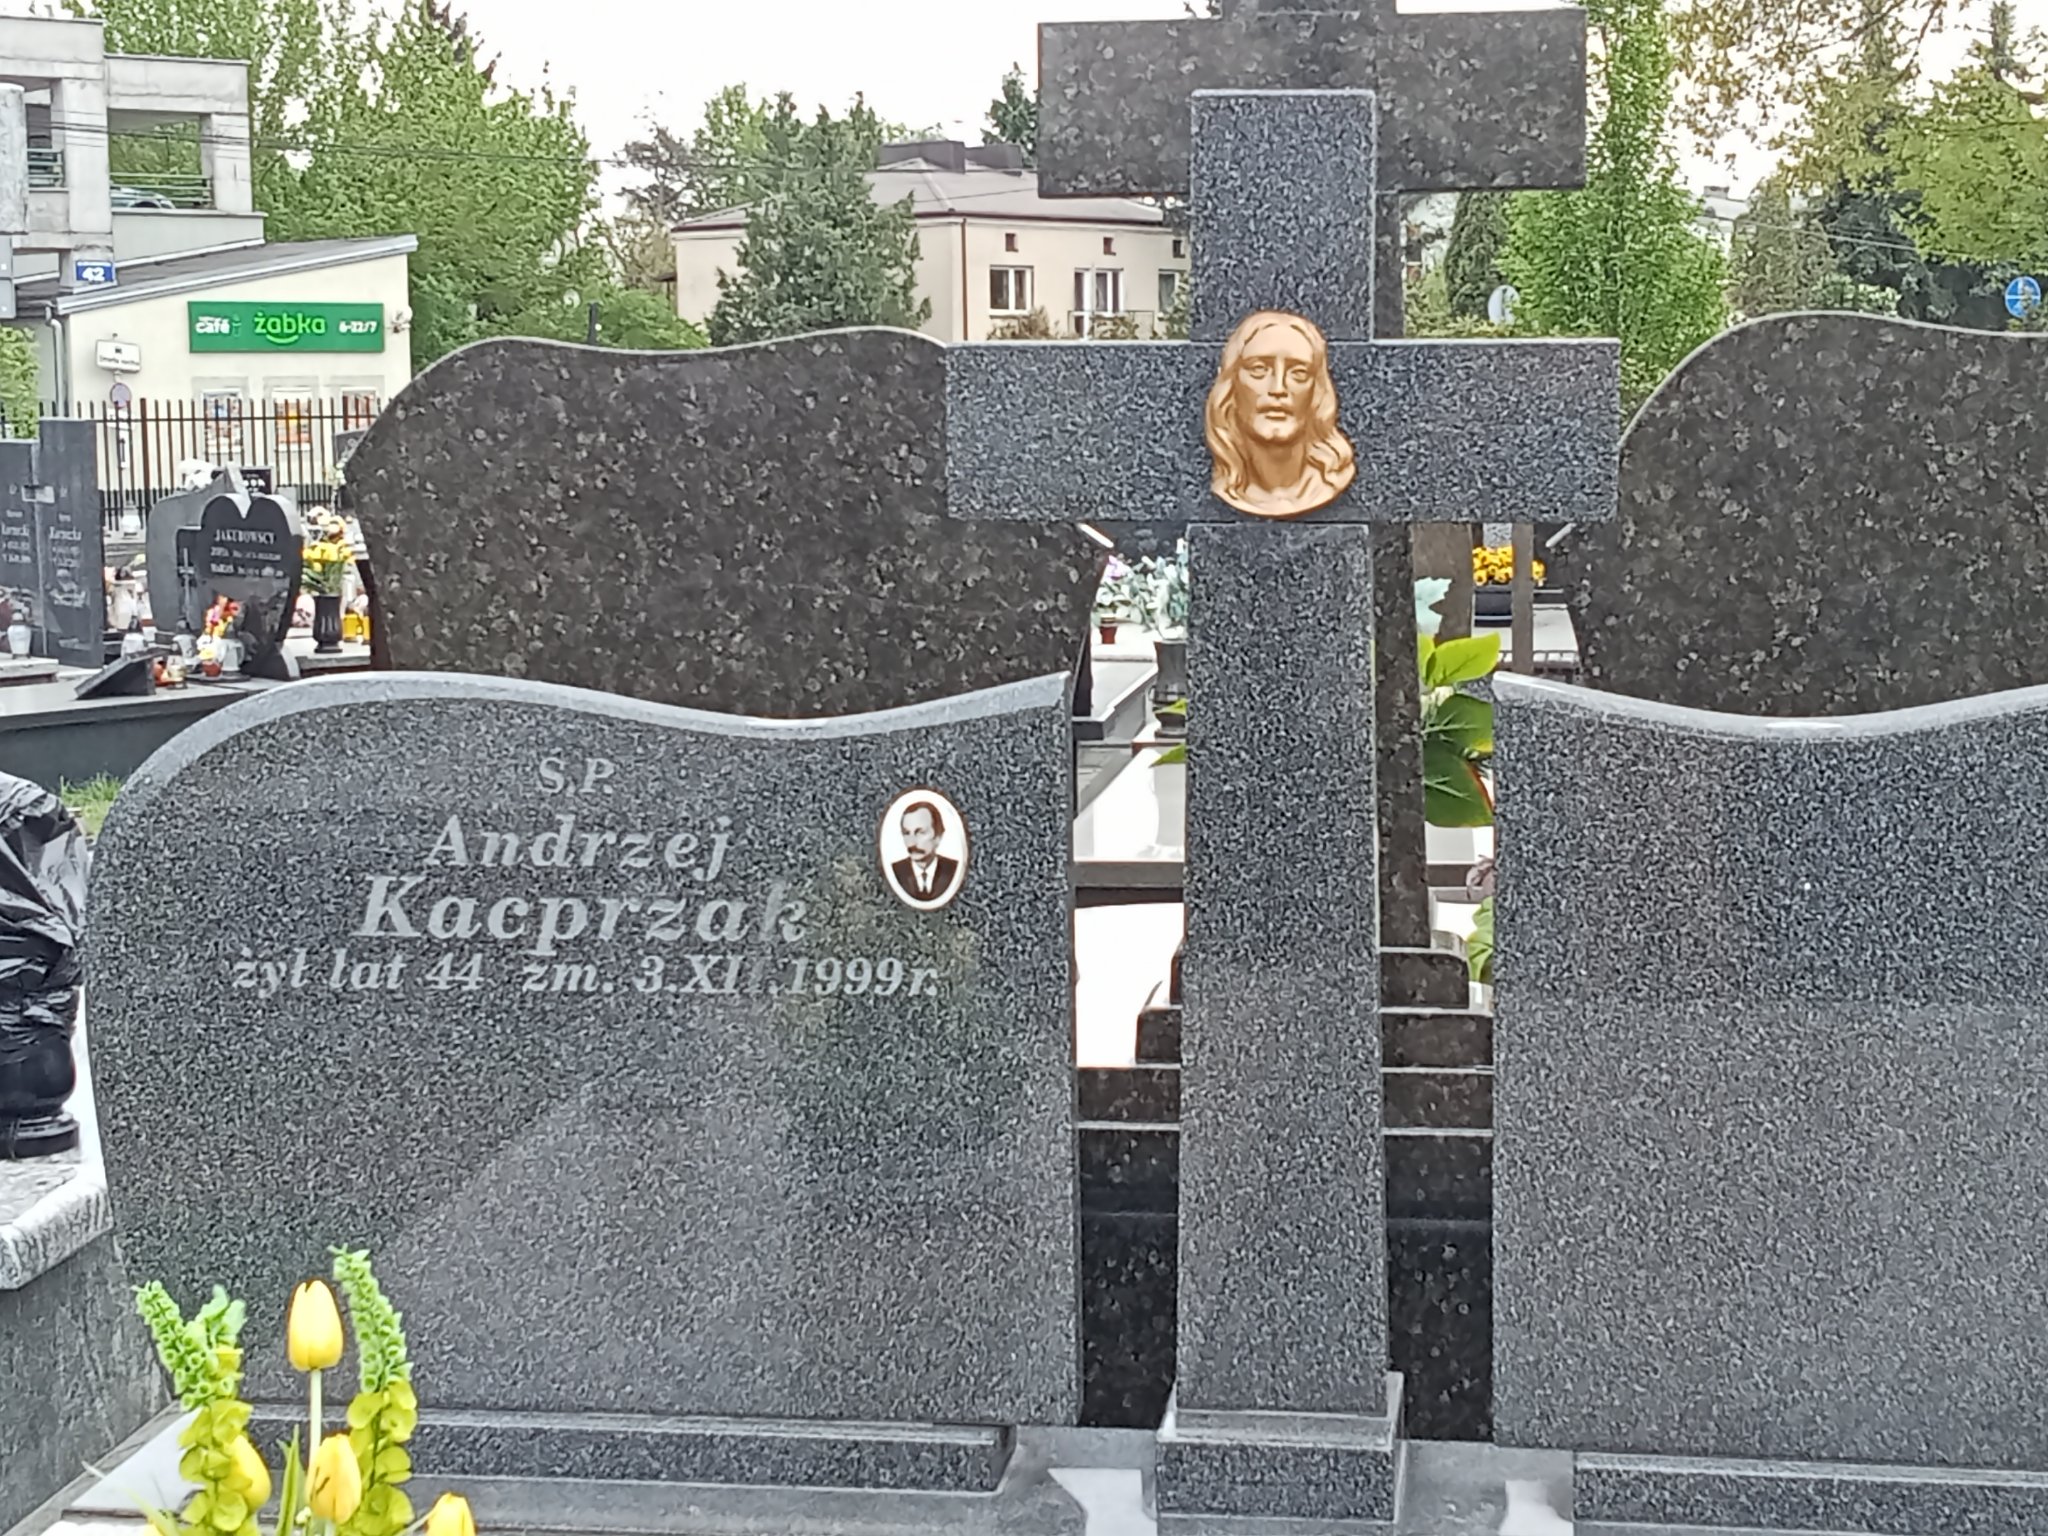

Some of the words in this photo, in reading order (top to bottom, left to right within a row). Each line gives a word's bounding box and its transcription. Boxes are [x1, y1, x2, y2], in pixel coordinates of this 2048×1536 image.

[82, 267, 105, 282] 42
[254, 312, 326, 334] żabka
[424, 814, 733, 881] Andrzej
[350, 876, 806, 956] Kacprzak
[330, 948, 406, 990] lat
[425, 952, 485, 991] 44
[522, 962, 614, 993] zm.
